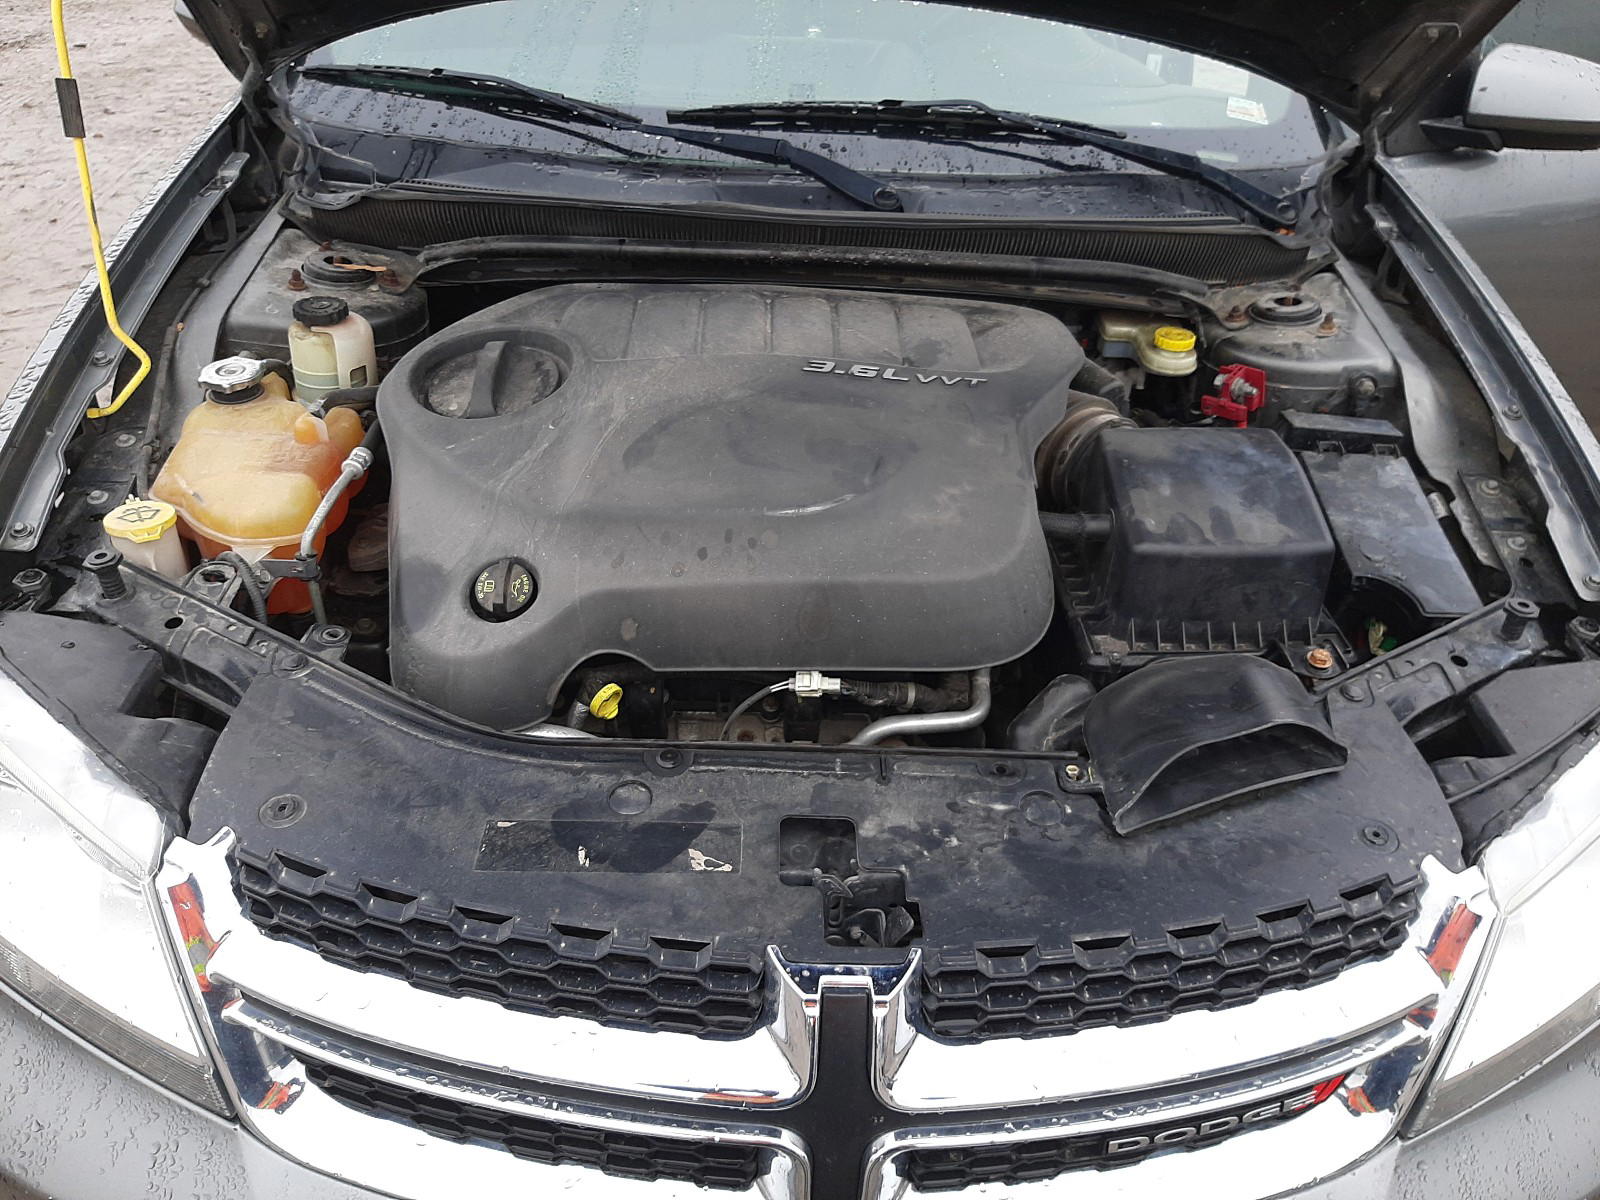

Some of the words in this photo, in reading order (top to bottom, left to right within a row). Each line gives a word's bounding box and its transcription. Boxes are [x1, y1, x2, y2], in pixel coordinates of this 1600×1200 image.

[802, 359, 910, 382] 3.6L
[915, 372, 989, 387] VVT
[1107, 1088, 1318, 1155] DODGE
